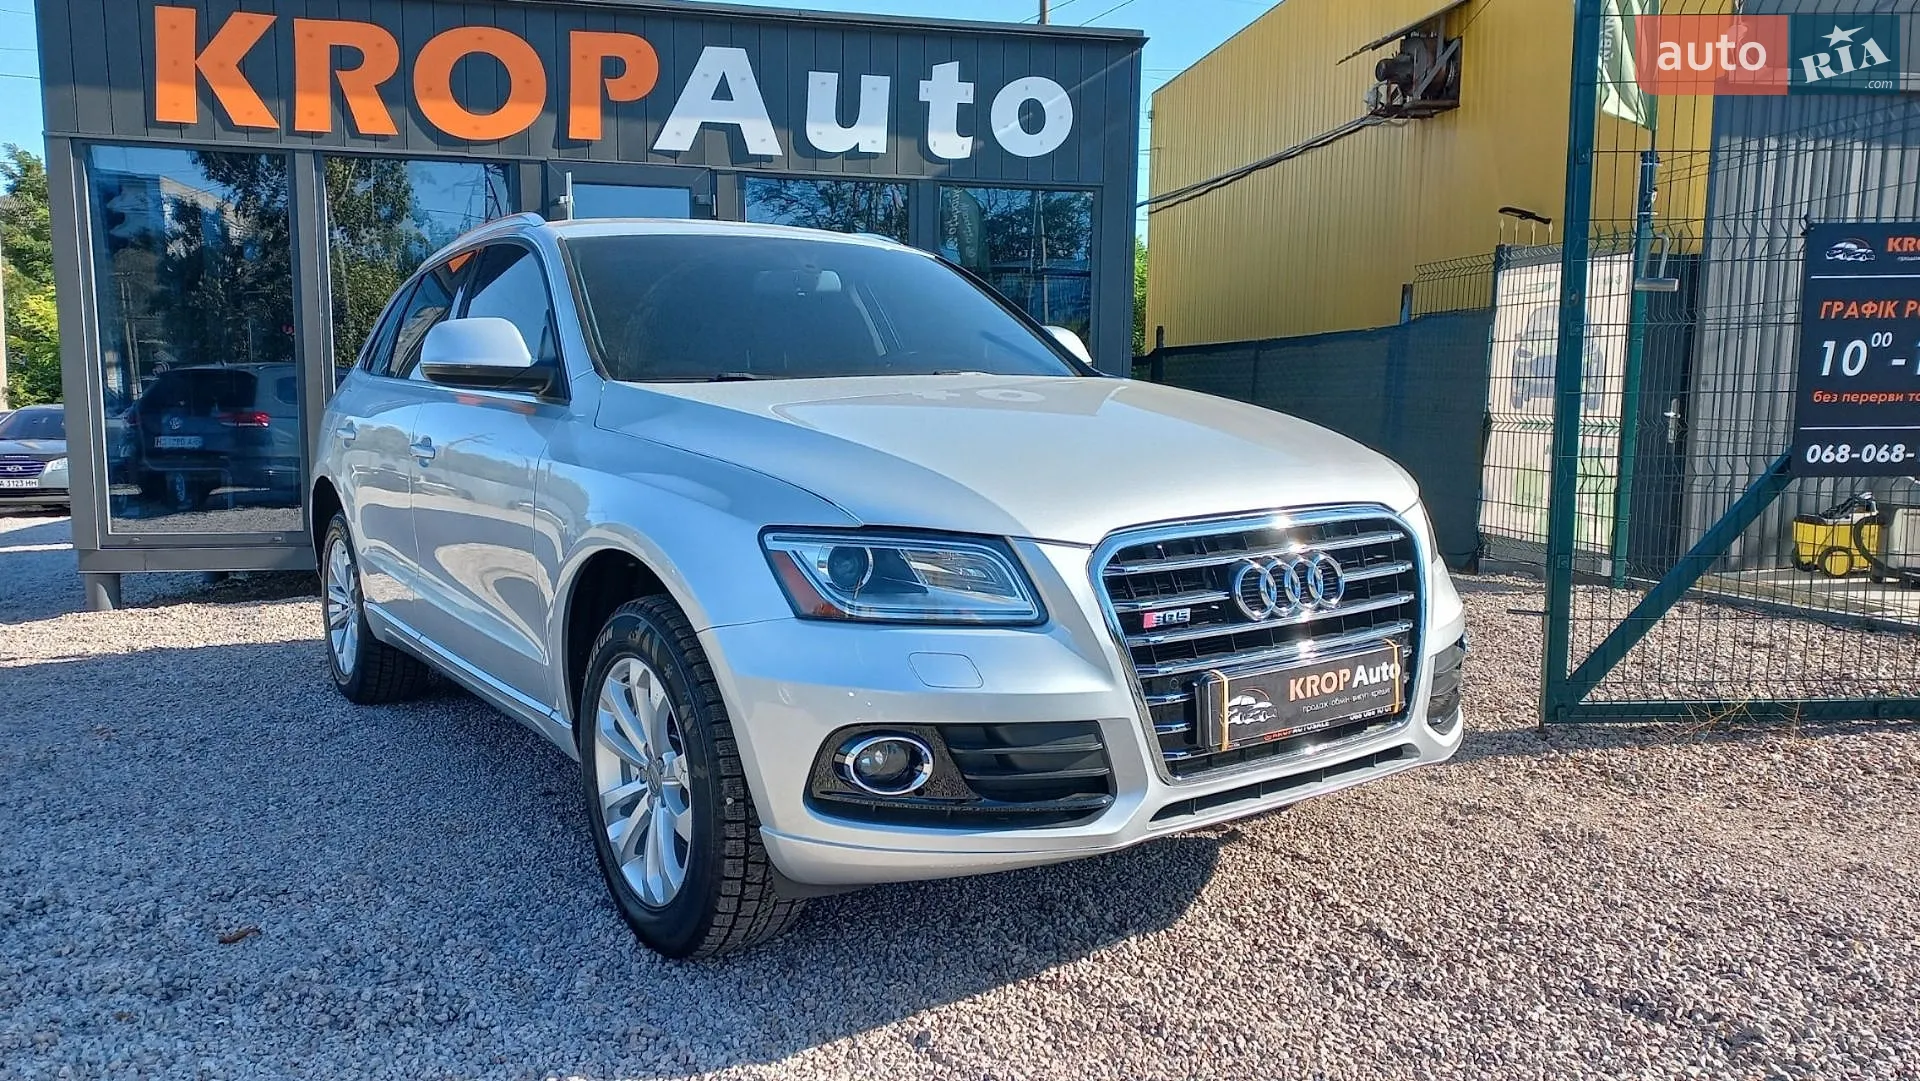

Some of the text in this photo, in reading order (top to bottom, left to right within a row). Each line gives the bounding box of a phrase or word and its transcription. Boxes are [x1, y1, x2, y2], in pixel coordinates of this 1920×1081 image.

[1887, 237, 1920, 252] KR
[1820, 300, 1920, 320] ГРАФІК Р
[1813, 390, 1839, 403] без
[1842, 393, 1904, 405] перерви
[1806, 443, 1920, 463] 068-068-
